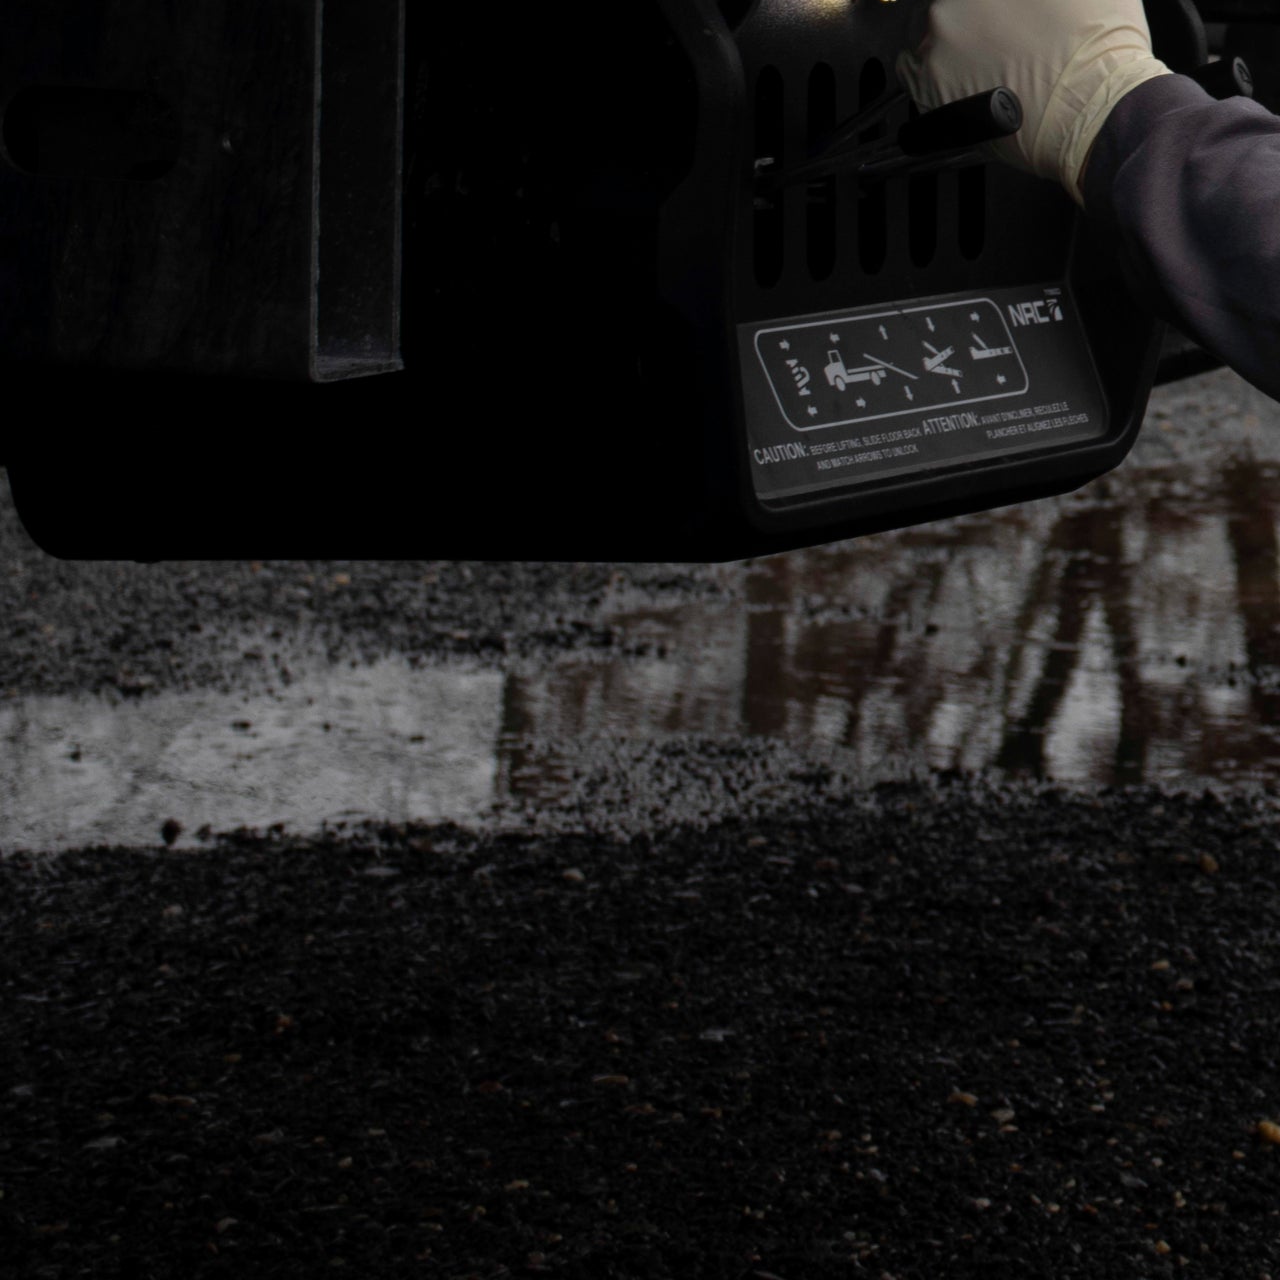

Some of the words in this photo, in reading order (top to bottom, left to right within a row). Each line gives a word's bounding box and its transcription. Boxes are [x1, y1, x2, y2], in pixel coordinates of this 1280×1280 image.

[1007, 300, 1050, 328] NRC
[922, 411, 982, 436] ATTENTION:
[982, 413, 1001, 425] AVANT
[1034, 403, 1060, 416] RECULEZ
[1060, 401, 1069, 412] LE
[986, 424, 1018, 439] PLANCHER
[1018, 423, 1027, 435] ET
[1051, 417, 1063, 429] LES
[753, 441, 809, 465] CAUTION:
[809, 441, 838, 456] BEFORE
[862, 434, 882, 446] SLIDE
[882, 431, 904, 444] FLOOR
[904, 427, 922, 439] BACK
[816, 459, 831, 471] AND
[831, 455, 855, 469] MATCH
[855, 451, 884, 464] ARROWS
[883, 448, 892, 460] TO
[893, 444, 919, 458] UNLOCK
